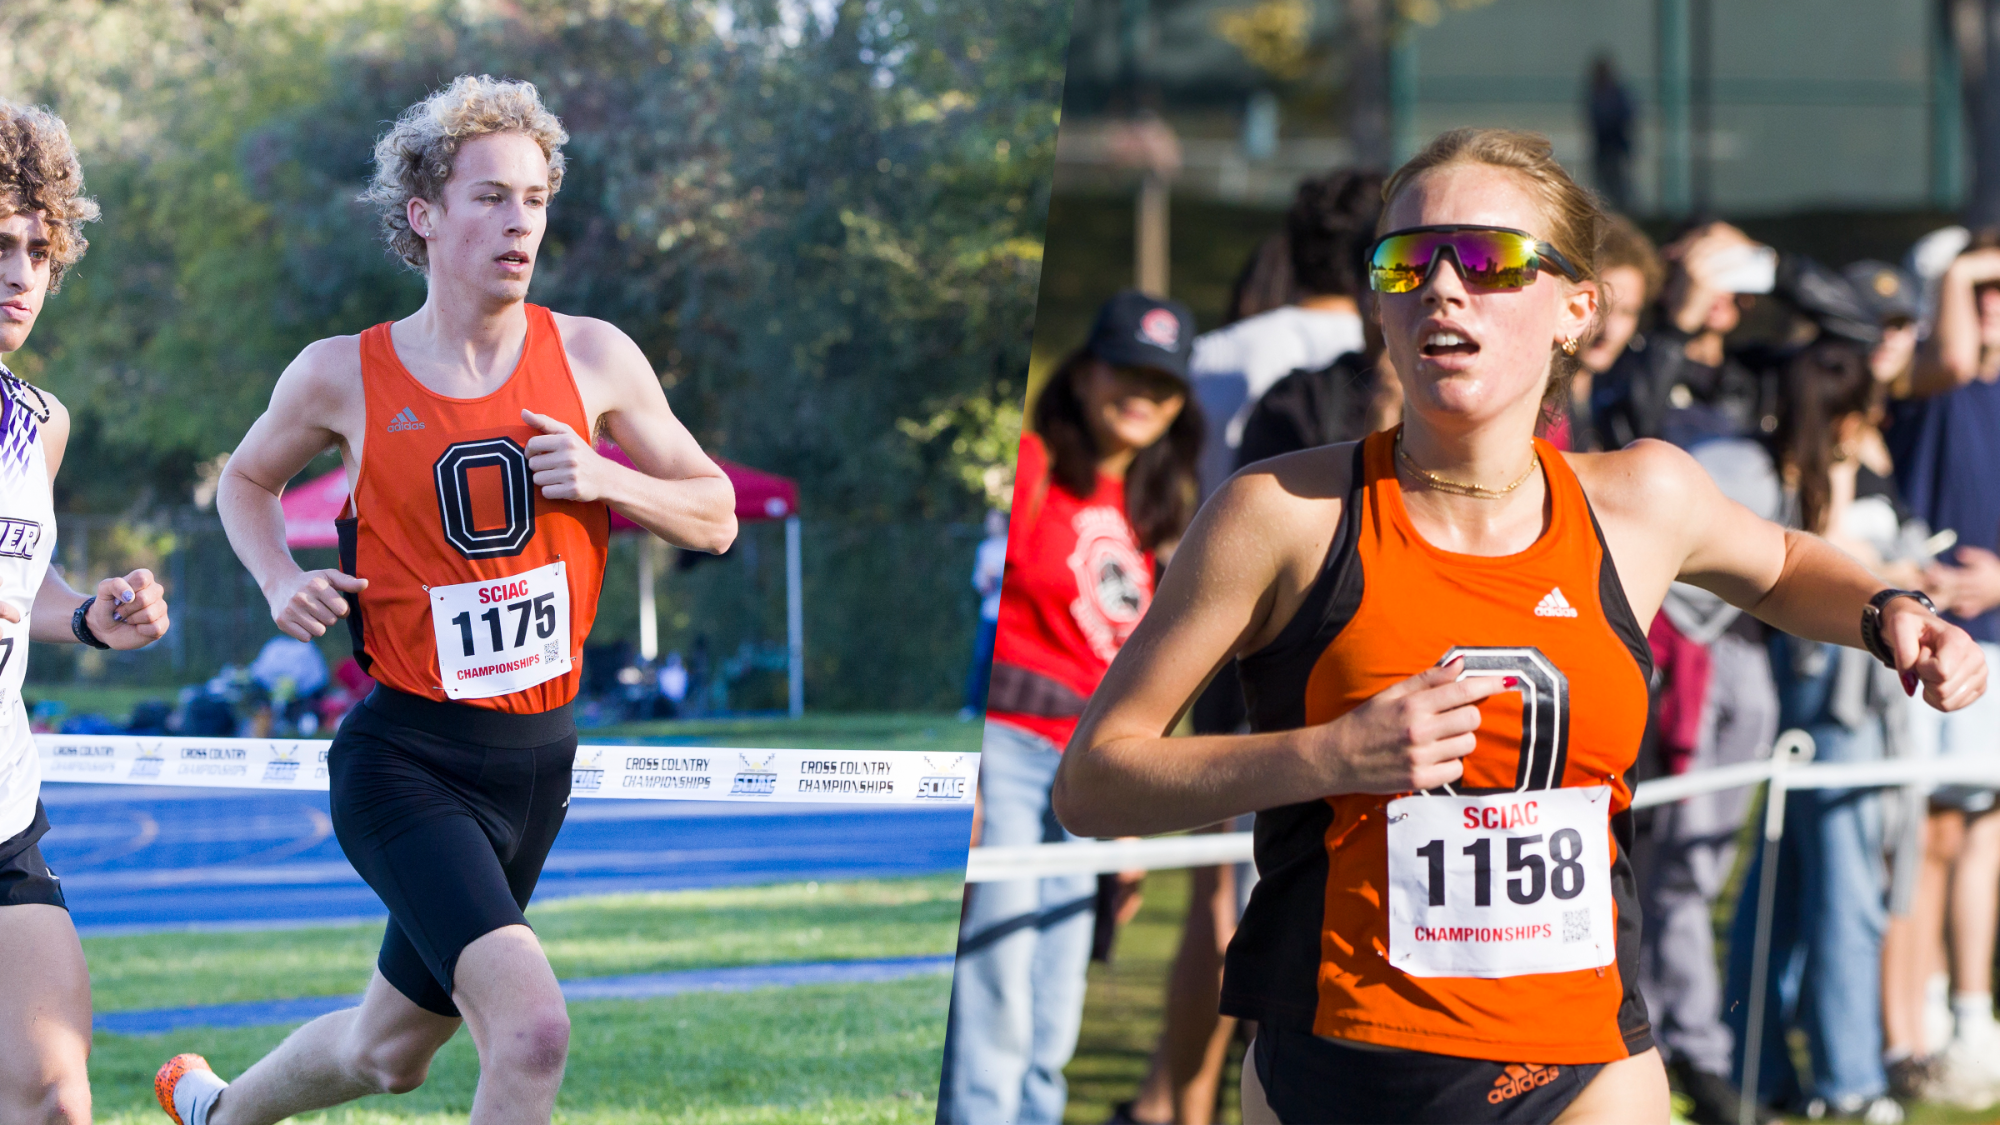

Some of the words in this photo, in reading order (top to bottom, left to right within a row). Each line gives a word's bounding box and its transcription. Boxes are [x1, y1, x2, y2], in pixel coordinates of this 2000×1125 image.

[387, 420, 426, 433] adidas
[478, 579, 529, 604] SCIAC
[1534, 605, 1578, 618] adidas
[452, 591, 556, 657] 1175
[457, 654, 540, 681] CHAMPIONSHIPS
[181, 748, 207, 759] CROSS
[209, 748, 246, 760] COUNTRY
[625, 757, 659, 770] CROSS
[661, 758, 710, 771] COUNTRY
[801, 760, 837, 775] CROSS
[840, 761, 893, 776] COUNTRY
[622, 775, 711, 789] CHAMPIONSHIPS
[732, 773, 776, 793] SCIAC
[798, 779, 894, 794] CHAMPIONSHIPS
[916, 777, 965, 798] SCIAC
[1463, 801, 1539, 830] SCIAC
[1416, 828, 1585, 907] 1158
[1415, 923, 1552, 943] CHAMPIONSHIPS
[1487, 1066, 1559, 1104] adidas
